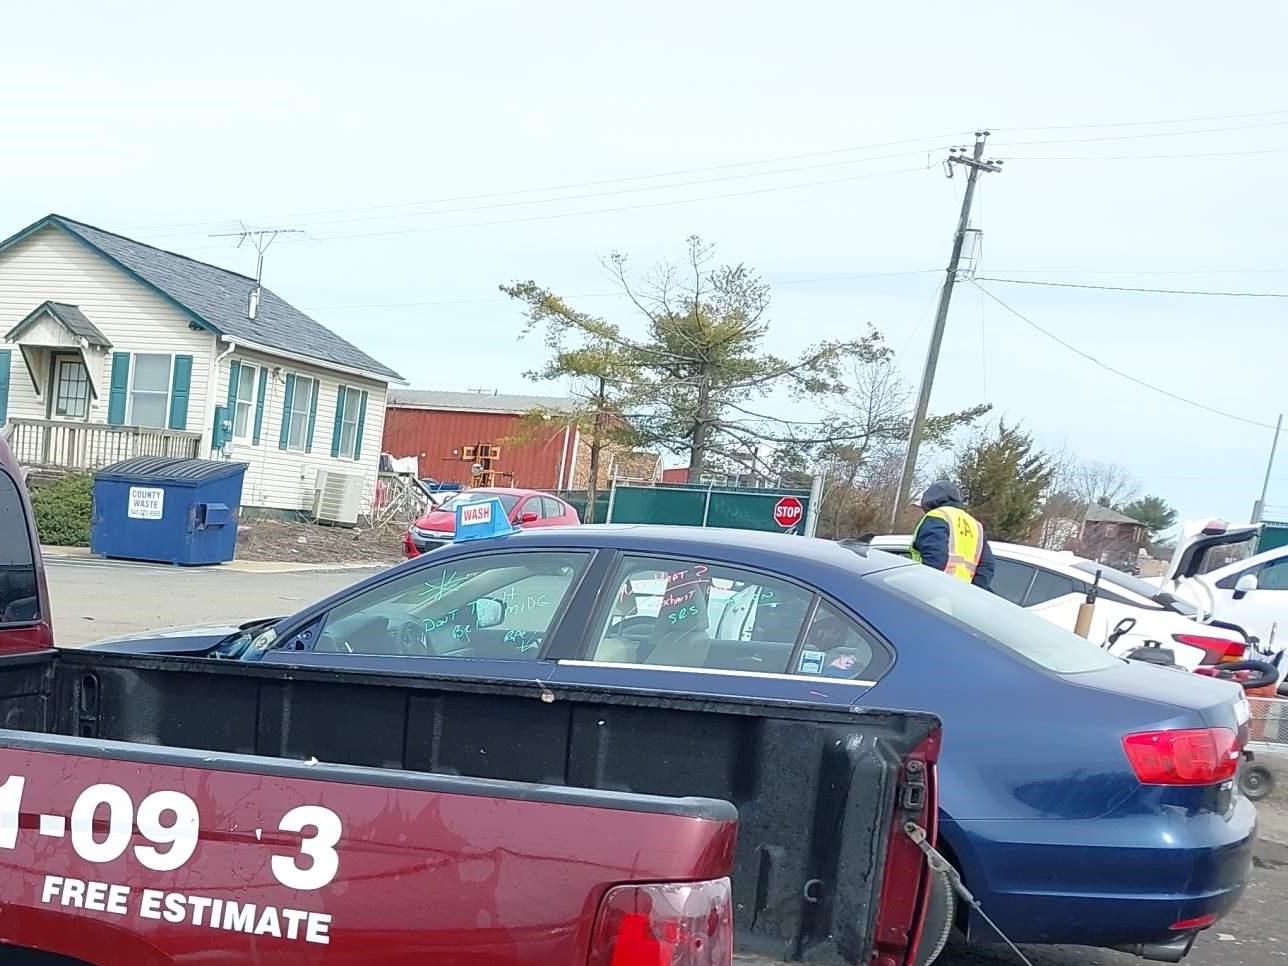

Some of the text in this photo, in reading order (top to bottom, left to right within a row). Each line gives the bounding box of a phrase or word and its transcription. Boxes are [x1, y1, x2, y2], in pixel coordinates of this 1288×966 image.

[132, 490, 161, 499] COUNTY
[133, 499, 159, 509] WASTE
[463, 507, 489, 521] WASH
[776, 506, 800, 518] STOP
[41, 875, 332, 945] FREE ESTIMATE
